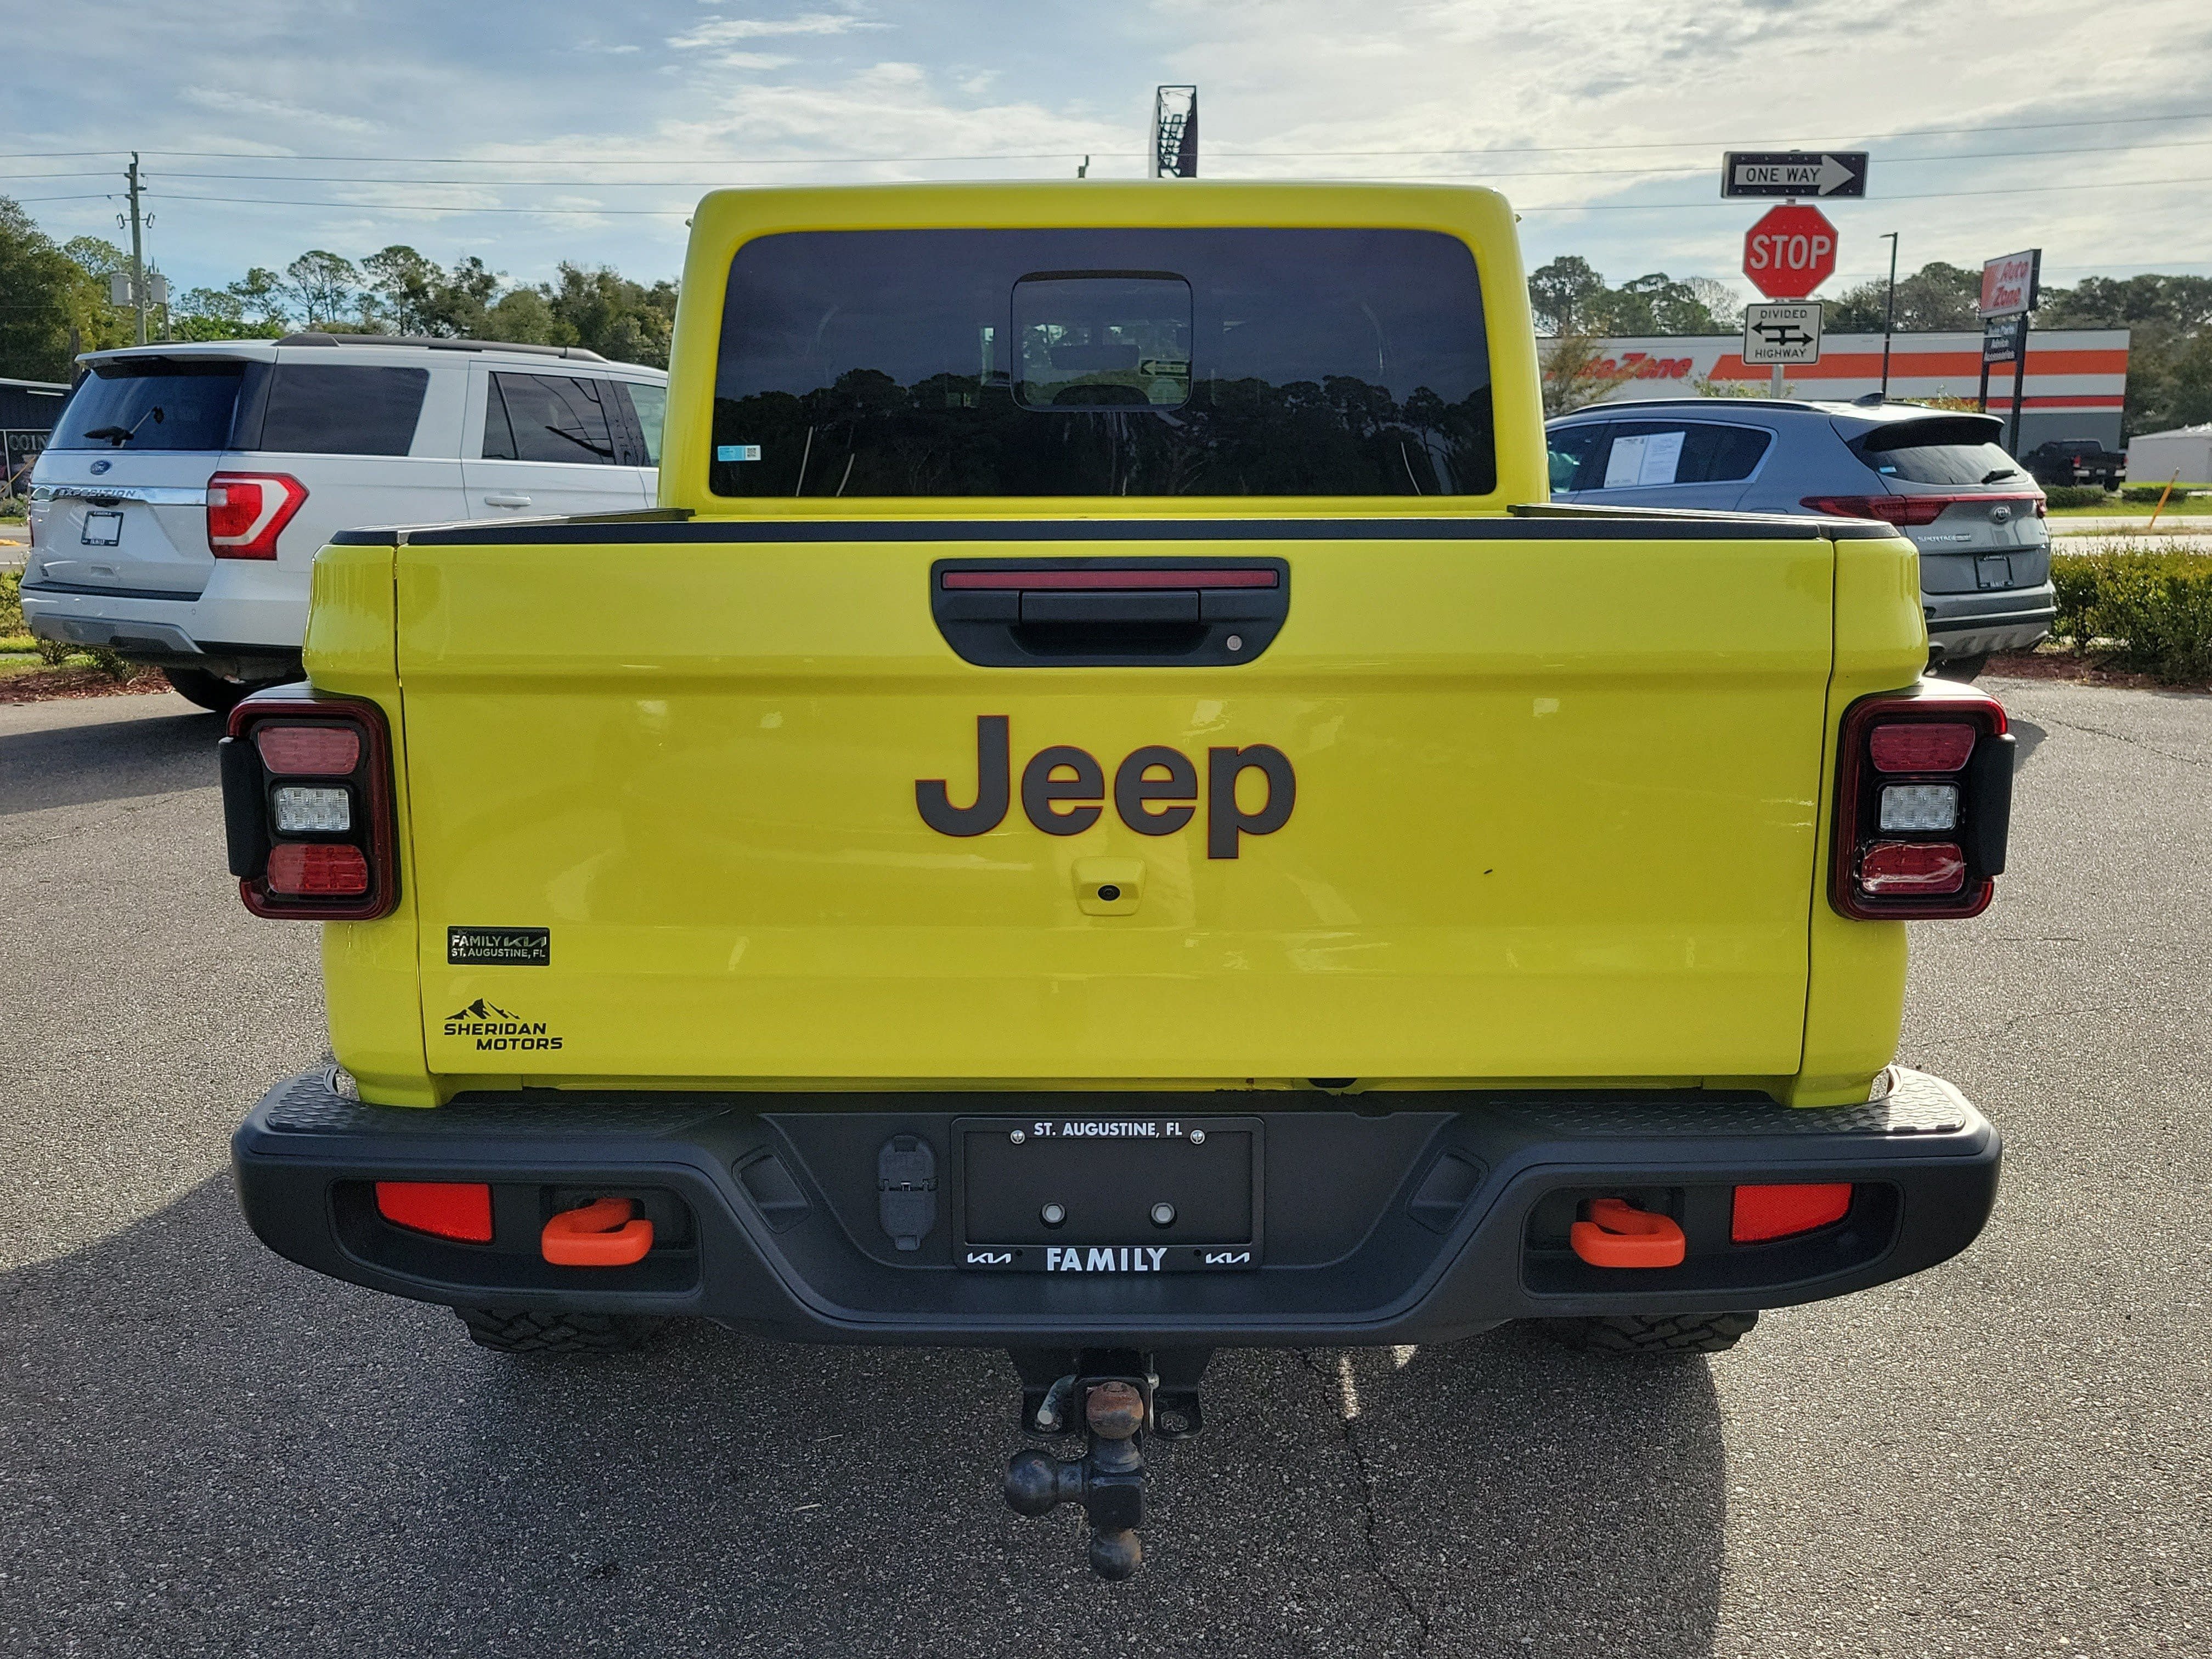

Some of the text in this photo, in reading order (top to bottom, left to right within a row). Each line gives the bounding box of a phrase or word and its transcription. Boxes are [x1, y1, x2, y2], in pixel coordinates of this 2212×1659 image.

[1746, 167, 1821, 182] ONE WAY
[1750, 234, 1831, 270] STOP
[1760, 309, 1807, 319] DIVIDED
[1755, 349, 1807, 358] HIGHWAY
[56, 488, 136, 496] EXPEDITION
[915, 715, 1296, 859] Jeep
[452, 935, 501, 946] FAMILY
[452, 947, 545, 958] ST. AUGUSTINE, FL
[444, 1023, 546, 1035] SHERIDAN
[476, 1037, 563, 1050] MOTORS
[1034, 1122, 1182, 1138] ST. AUGUSTINE, FL
[1047, 1248, 1167, 1271] FAMILY
